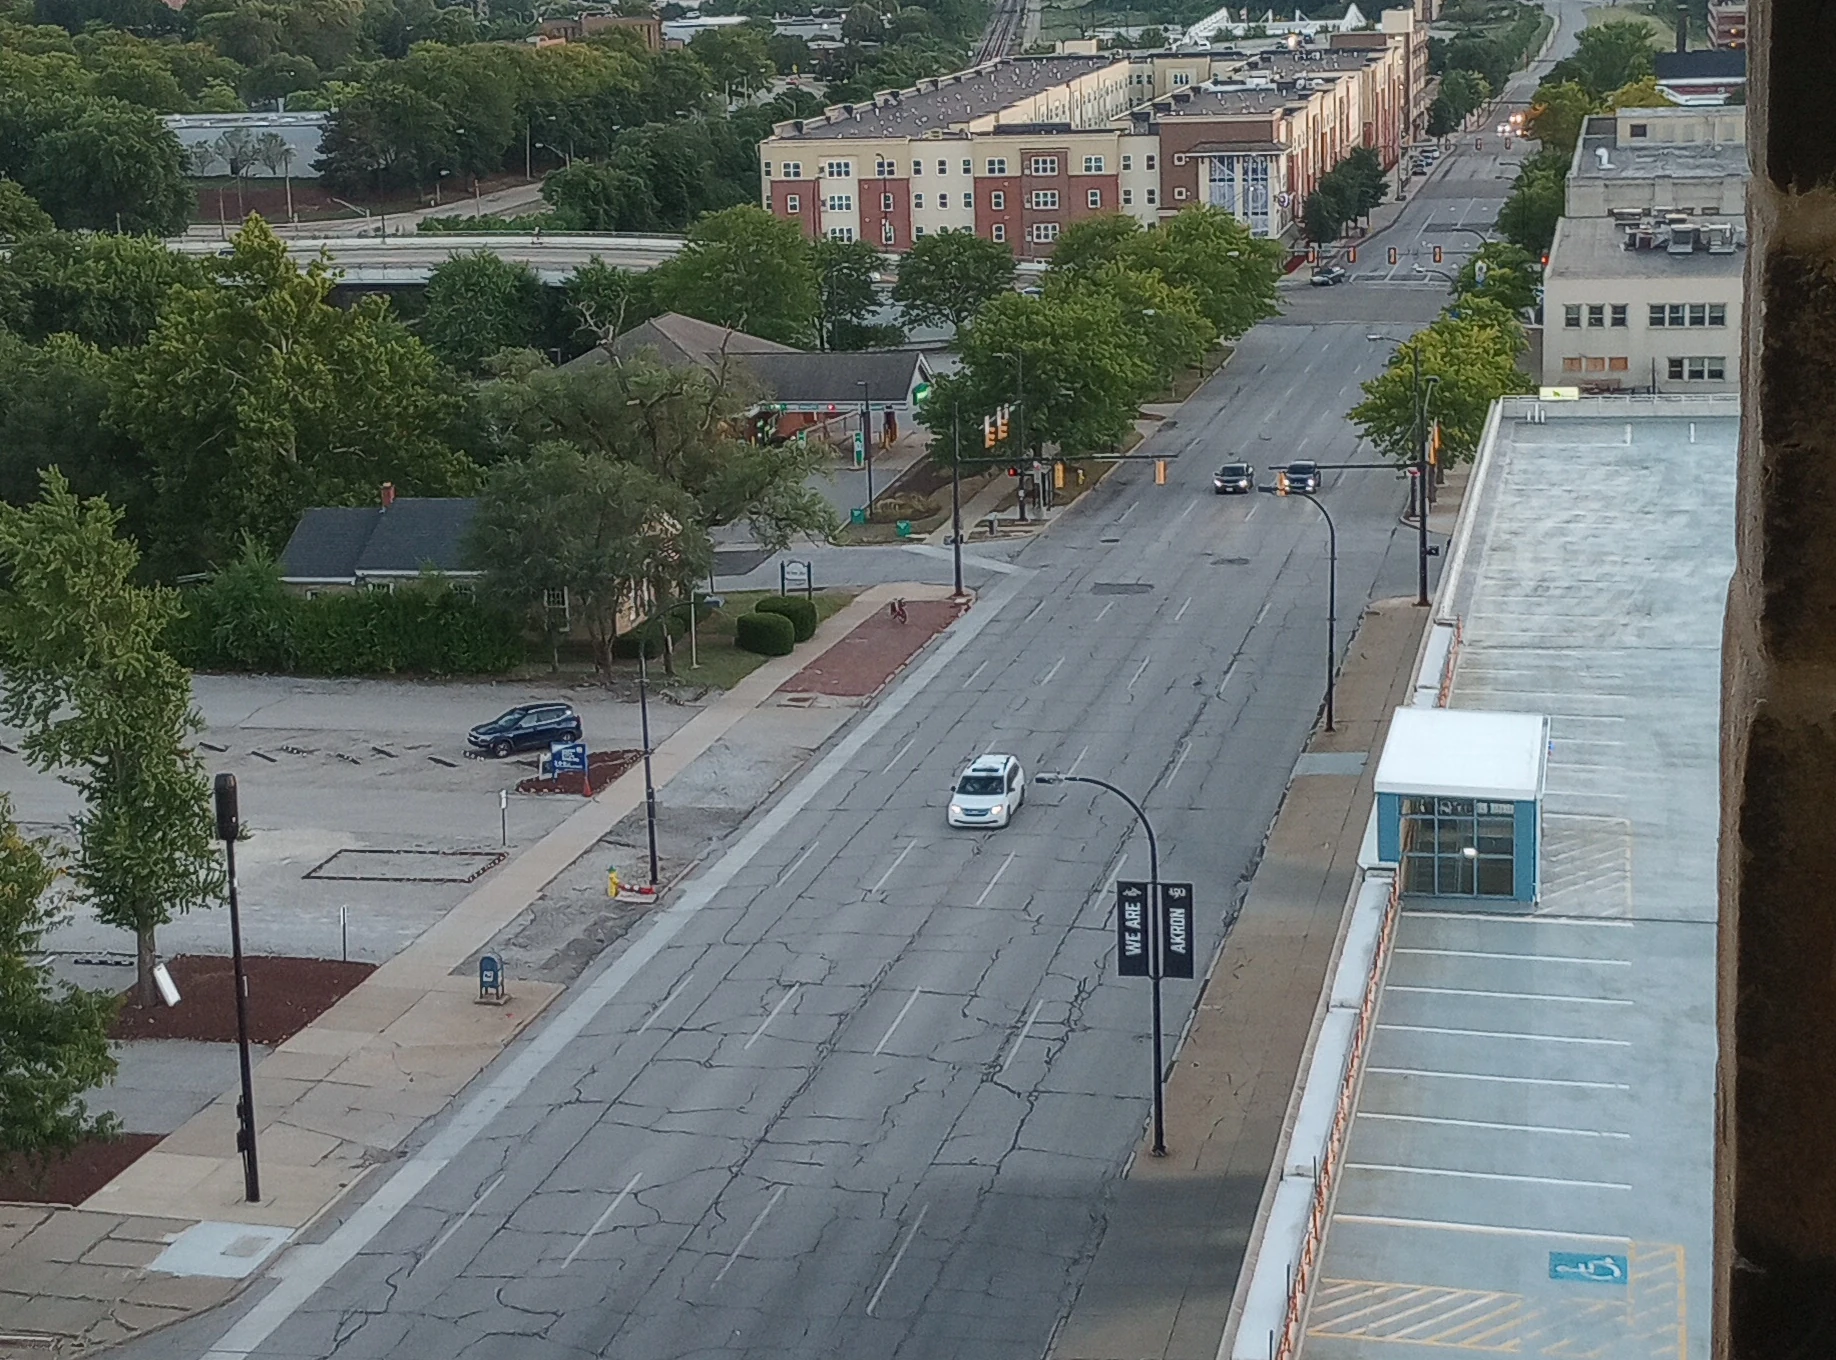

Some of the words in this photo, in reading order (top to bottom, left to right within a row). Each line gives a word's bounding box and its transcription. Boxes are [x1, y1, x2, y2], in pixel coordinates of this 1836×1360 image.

[1125, 902, 1141, 929] ARE
[1125, 932, 1142, 956] WE
[1169, 908, 1186, 954] AKRON
